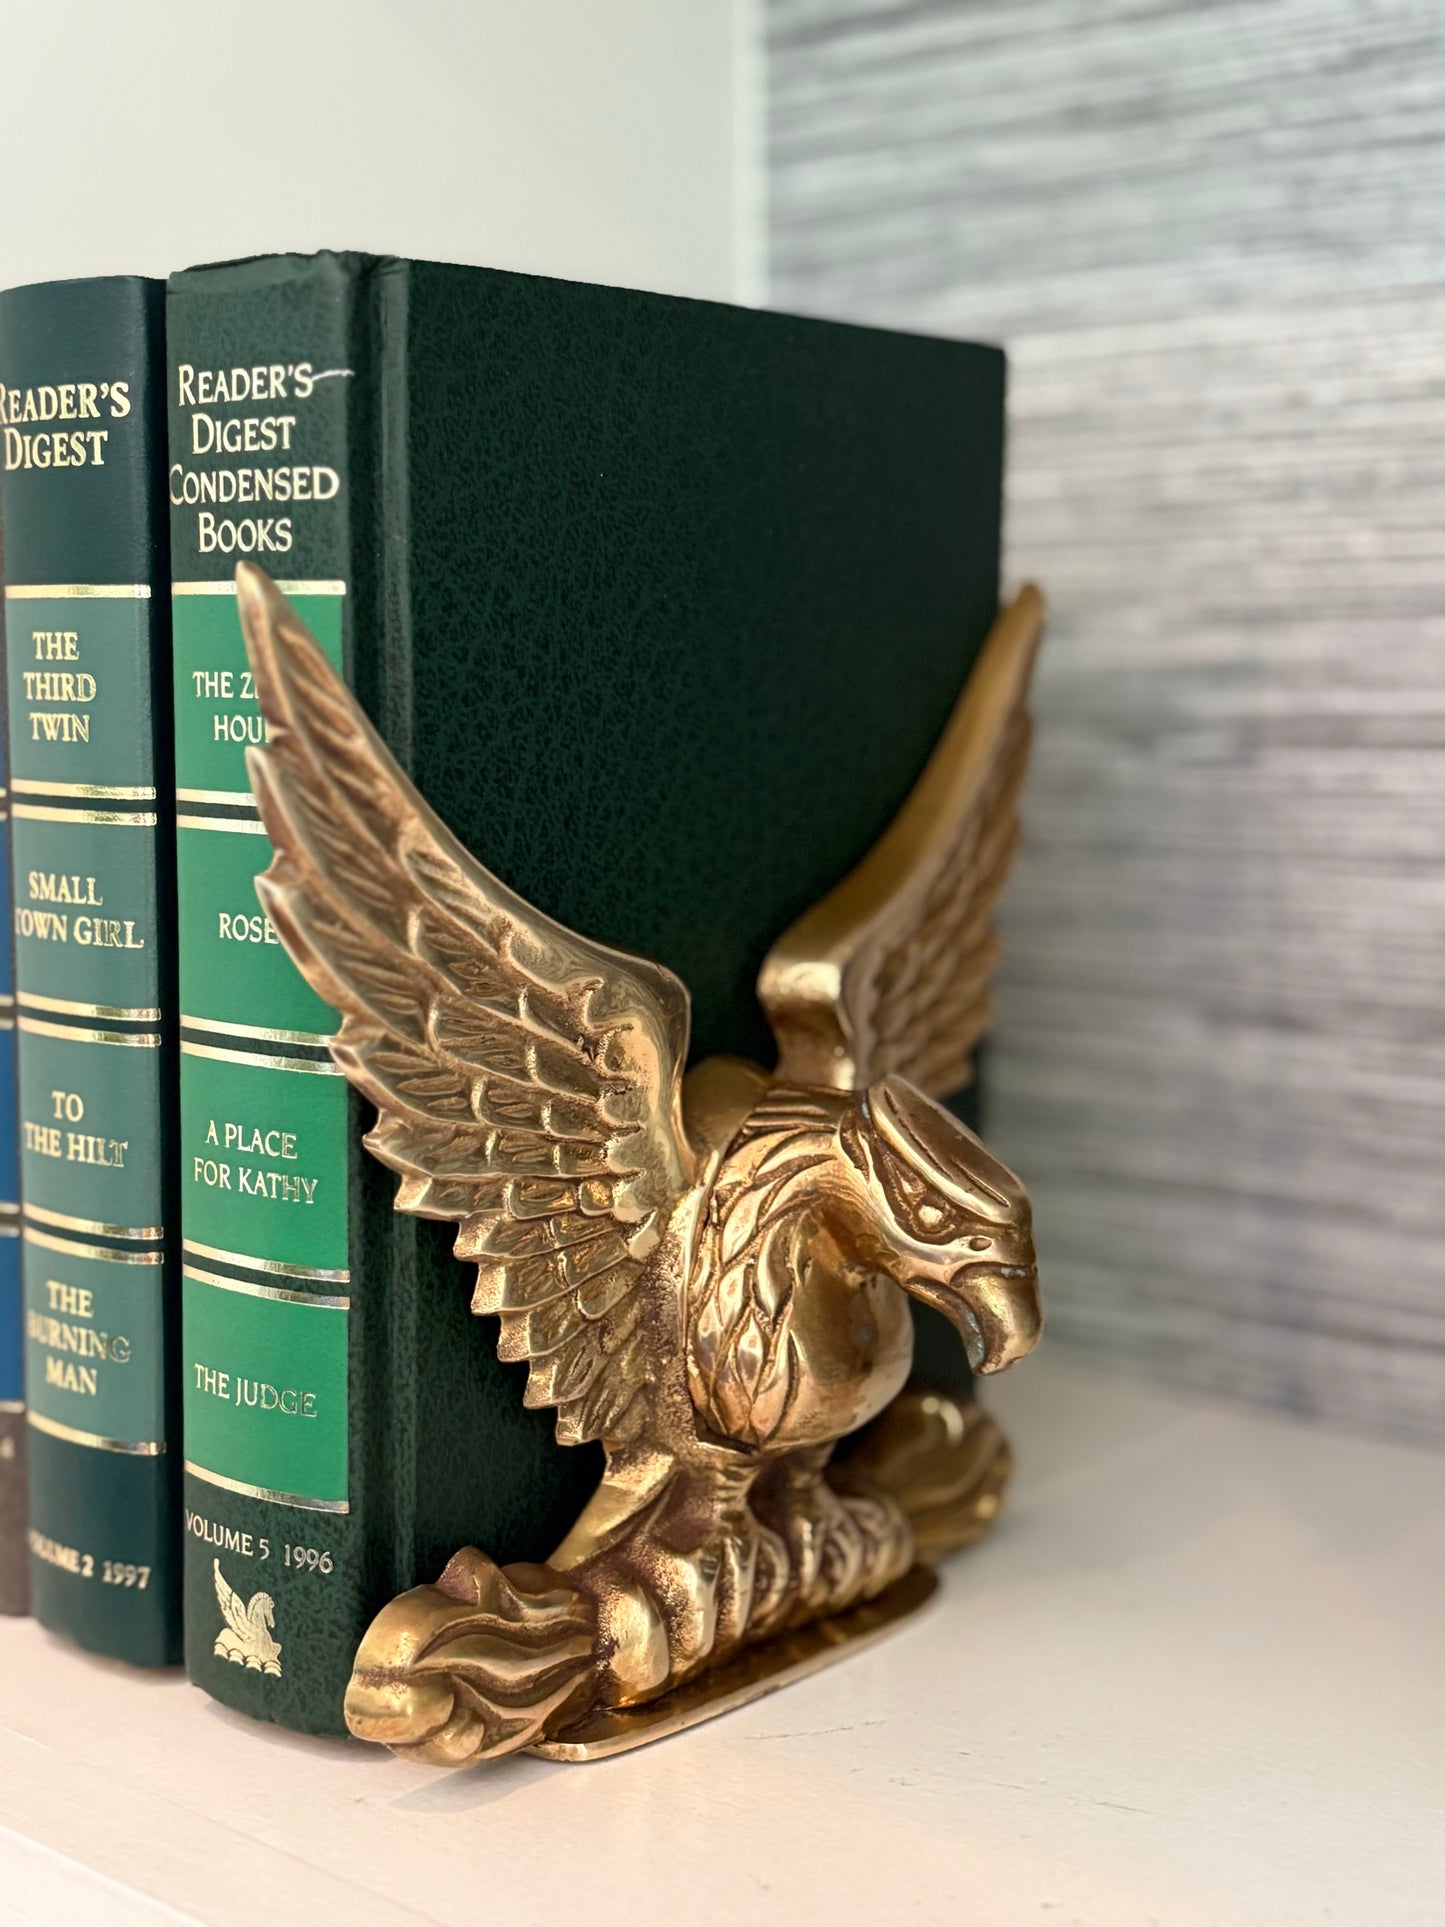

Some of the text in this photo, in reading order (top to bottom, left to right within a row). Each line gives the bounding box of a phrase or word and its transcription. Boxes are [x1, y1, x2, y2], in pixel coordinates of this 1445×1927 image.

[178, 363, 314, 406] READER'S
[4, 427, 109, 471] DIGEST
[192, 413, 296, 455] DIGEST
[170, 463, 340, 505] CONDENSED
[198, 512, 294, 553] BOOKS
[32, 632, 80, 661] THE
[23, 671, 97, 702] THIRD
[192, 671, 234, 699] THE
[29, 712, 90, 743] TWIN
[28, 870, 104, 906] SMALL
[73, 916, 145, 949] GIRL
[51, 1090, 84, 1123] TO
[24, 1121, 129, 1168] THE HILT
[205, 1120, 298, 1160] A PLACE
[193, 1157, 319, 1204] FOR KATHY
[46, 1279, 94, 1319] THE
[46, 1355, 97, 1397] MAN
[194, 1363, 318, 1418] THE JUDGE
[185, 1508, 334, 1575] VOLUME 5 1996
[81, 1553, 95, 1578] 2
[102, 1559, 152, 1591] 1997
